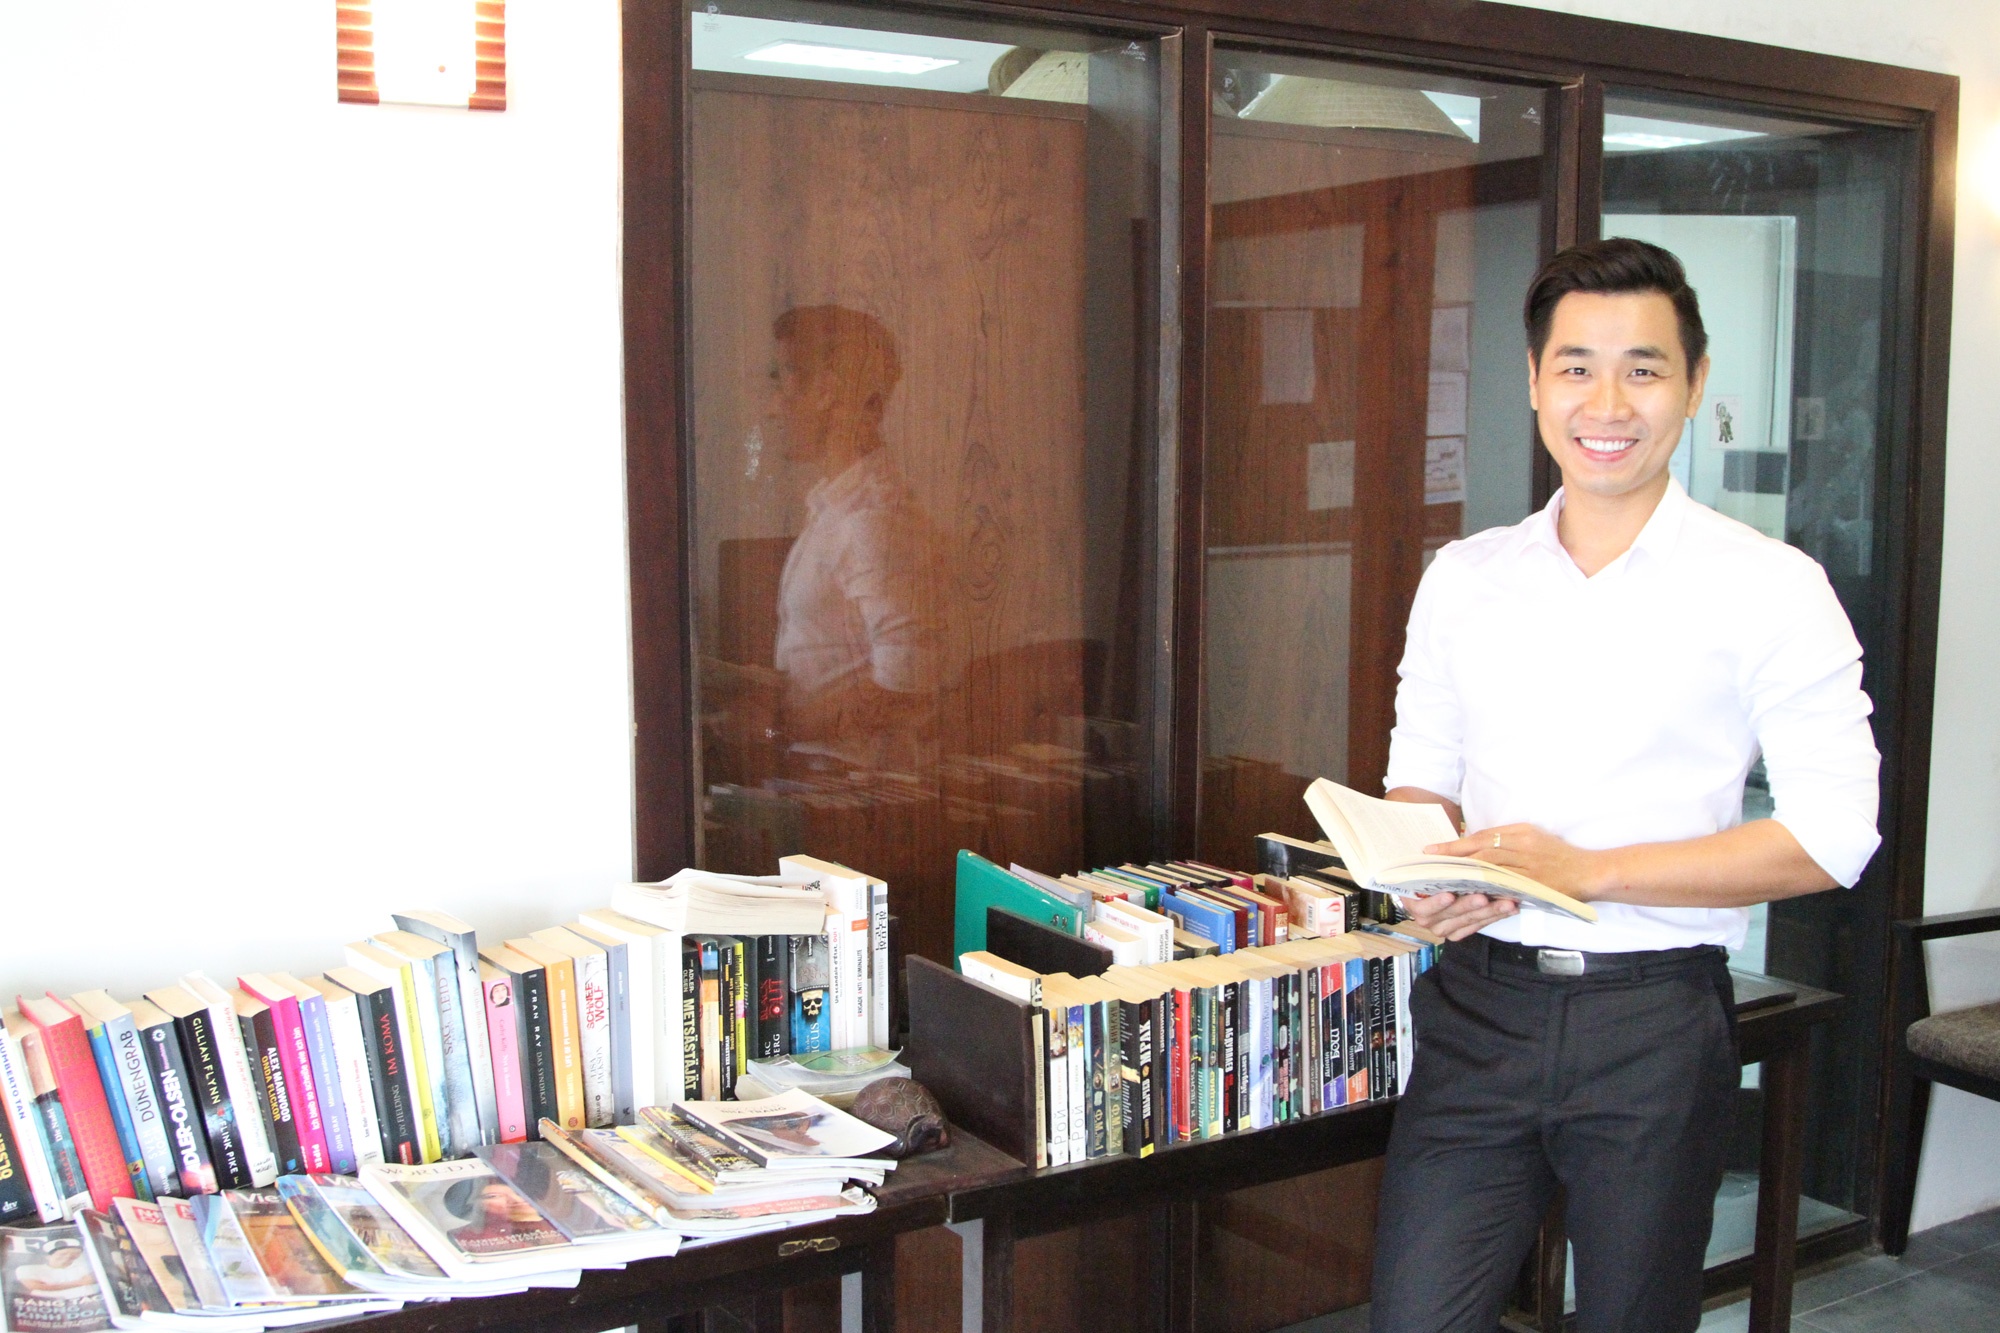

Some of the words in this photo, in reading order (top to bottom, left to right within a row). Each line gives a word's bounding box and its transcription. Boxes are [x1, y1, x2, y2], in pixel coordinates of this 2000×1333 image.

[440, 977, 452, 1012] LEID
[585, 982, 595, 1030] SCHNEE
[593, 985, 605, 1023] WOLF
[380, 1014, 396, 1055] KOMA
[531, 989, 539, 1020] FRAN
[538, 1068, 548, 1105] SYNDIKAT
[682, 998, 699, 1090] METSÄSTÄJÄT
[1140, 1020, 1152, 1066] МРАК
[1224, 1027, 1234, 1073] АБДУЛЛАЕВ
[1330, 1028, 1340, 1060] Бош
[1354, 1021, 1364, 1053] Бош
[193, 1017, 211, 1068] GILLIAN
[203, 1066, 221, 1104] FLYNN
[261, 1055, 272, 1082] ONDA
[267, 1046, 280, 1070] ALEX
[386, 1058, 398, 1076] IM
[0, 1038, 19, 1098] HUMBERTO
[15, 1098, 26, 1120] TAN
[120, 1030, 155, 1123] DÜNENGRAB
[267, 1083, 280, 1122] FLICKOR
[272, 1070, 292, 1122] MARWOOD
[306, 1102, 318, 1118] bleib
[326, 1087, 335, 1108] Männer
[392, 1084, 406, 1123] FIELDING
[1142, 1079, 1151, 1120] КОЛЫЧЕВ
[47, 1108, 60, 1132] Nadel
[220, 1120, 233, 1150] FLINK
[332, 1116, 340, 1135] GRAY
[54, 1132, 64, 1142] Die
[335, 1136, 344, 1152] JOHN
[226, 1150, 238, 1174] PIKE
[312, 1144, 324, 1168] PIPER
[16, 1311, 62, 1320] KINH
